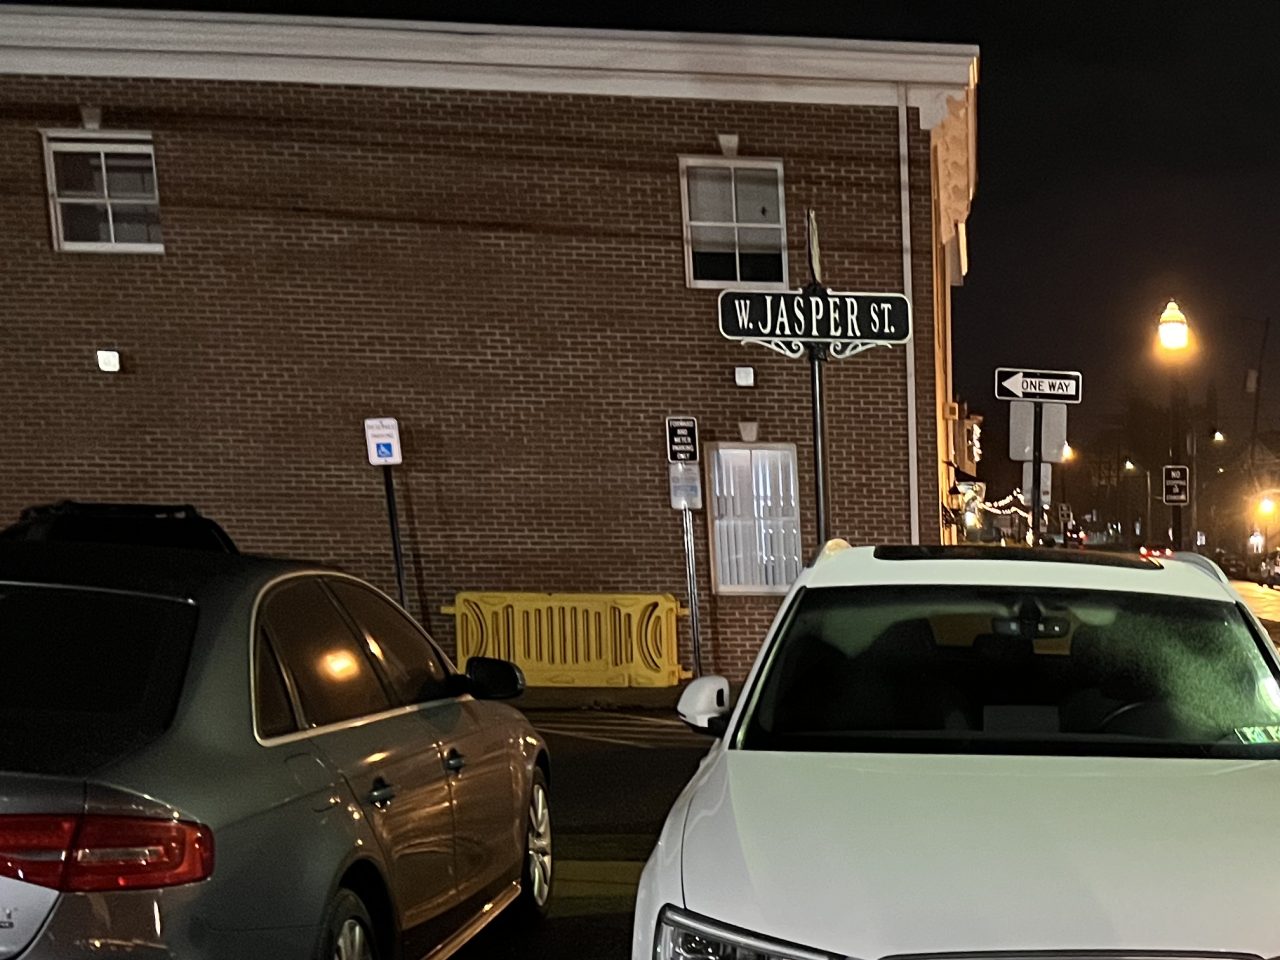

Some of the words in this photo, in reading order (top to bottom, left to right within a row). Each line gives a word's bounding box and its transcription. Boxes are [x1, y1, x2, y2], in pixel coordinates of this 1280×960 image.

[735, 300, 753, 330] W.
[758, 295, 861, 337] JASPER
[870, 302, 895, 333] ST.
[1021, 379, 1045, 393] ONE
[1048, 381, 1071, 394] WAY
[1170, 470, 1181, 478] NO
